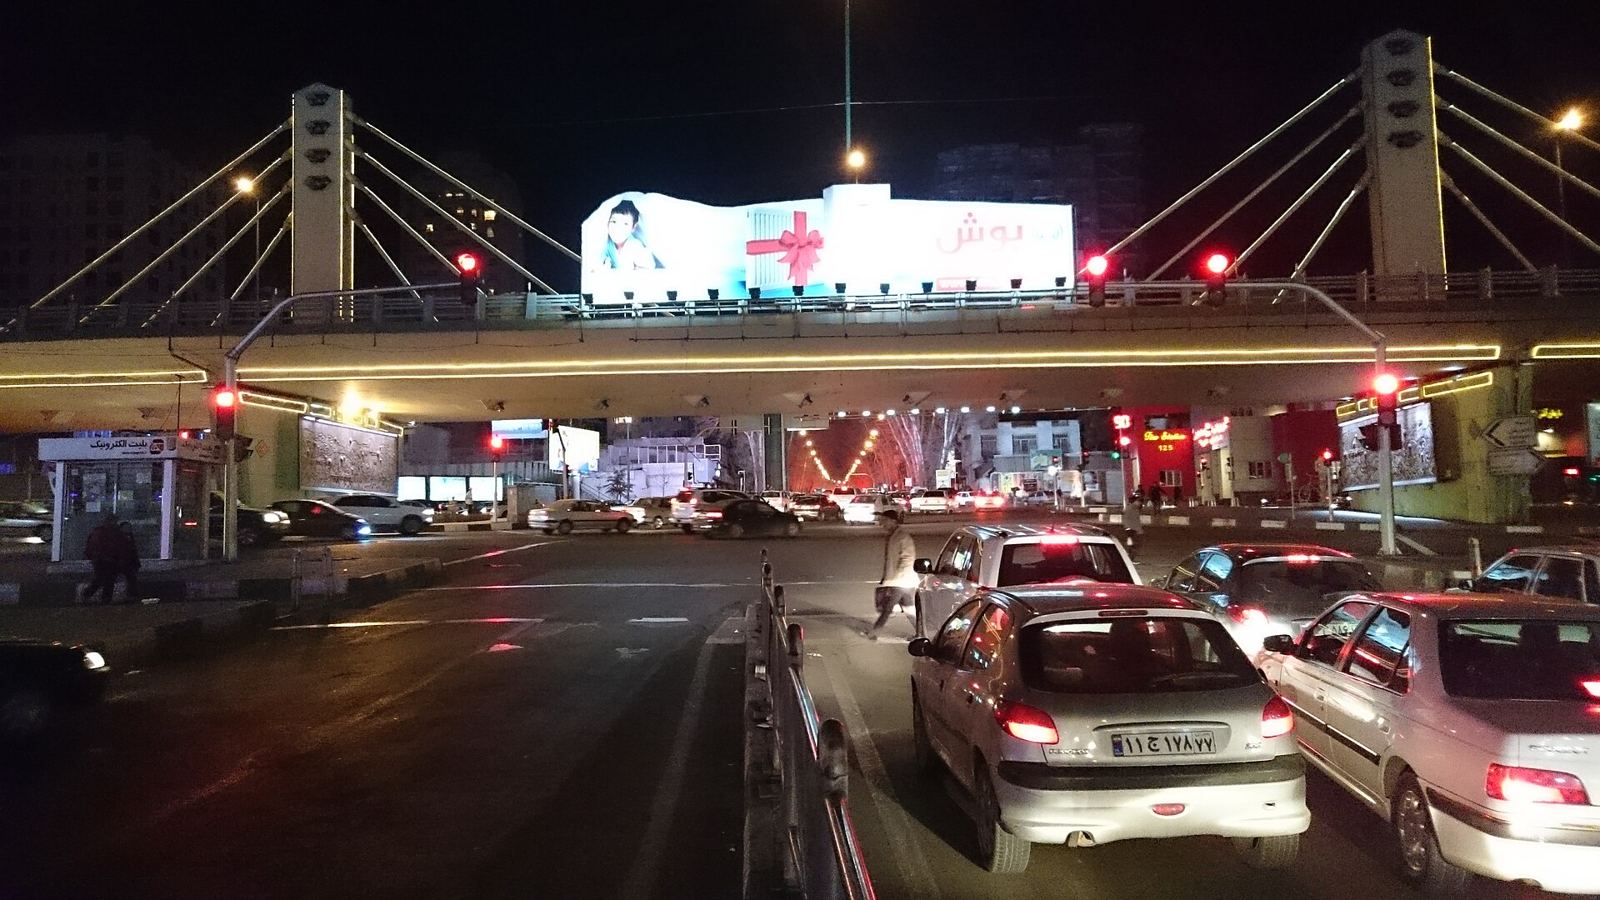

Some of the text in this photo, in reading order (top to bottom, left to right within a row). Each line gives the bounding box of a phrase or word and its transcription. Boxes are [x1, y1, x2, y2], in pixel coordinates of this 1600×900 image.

[90, 439, 127, 450] الکترونیک
[1158, 444, 1174, 452] 125
[1125, 737, 1143, 753] ۱۱
